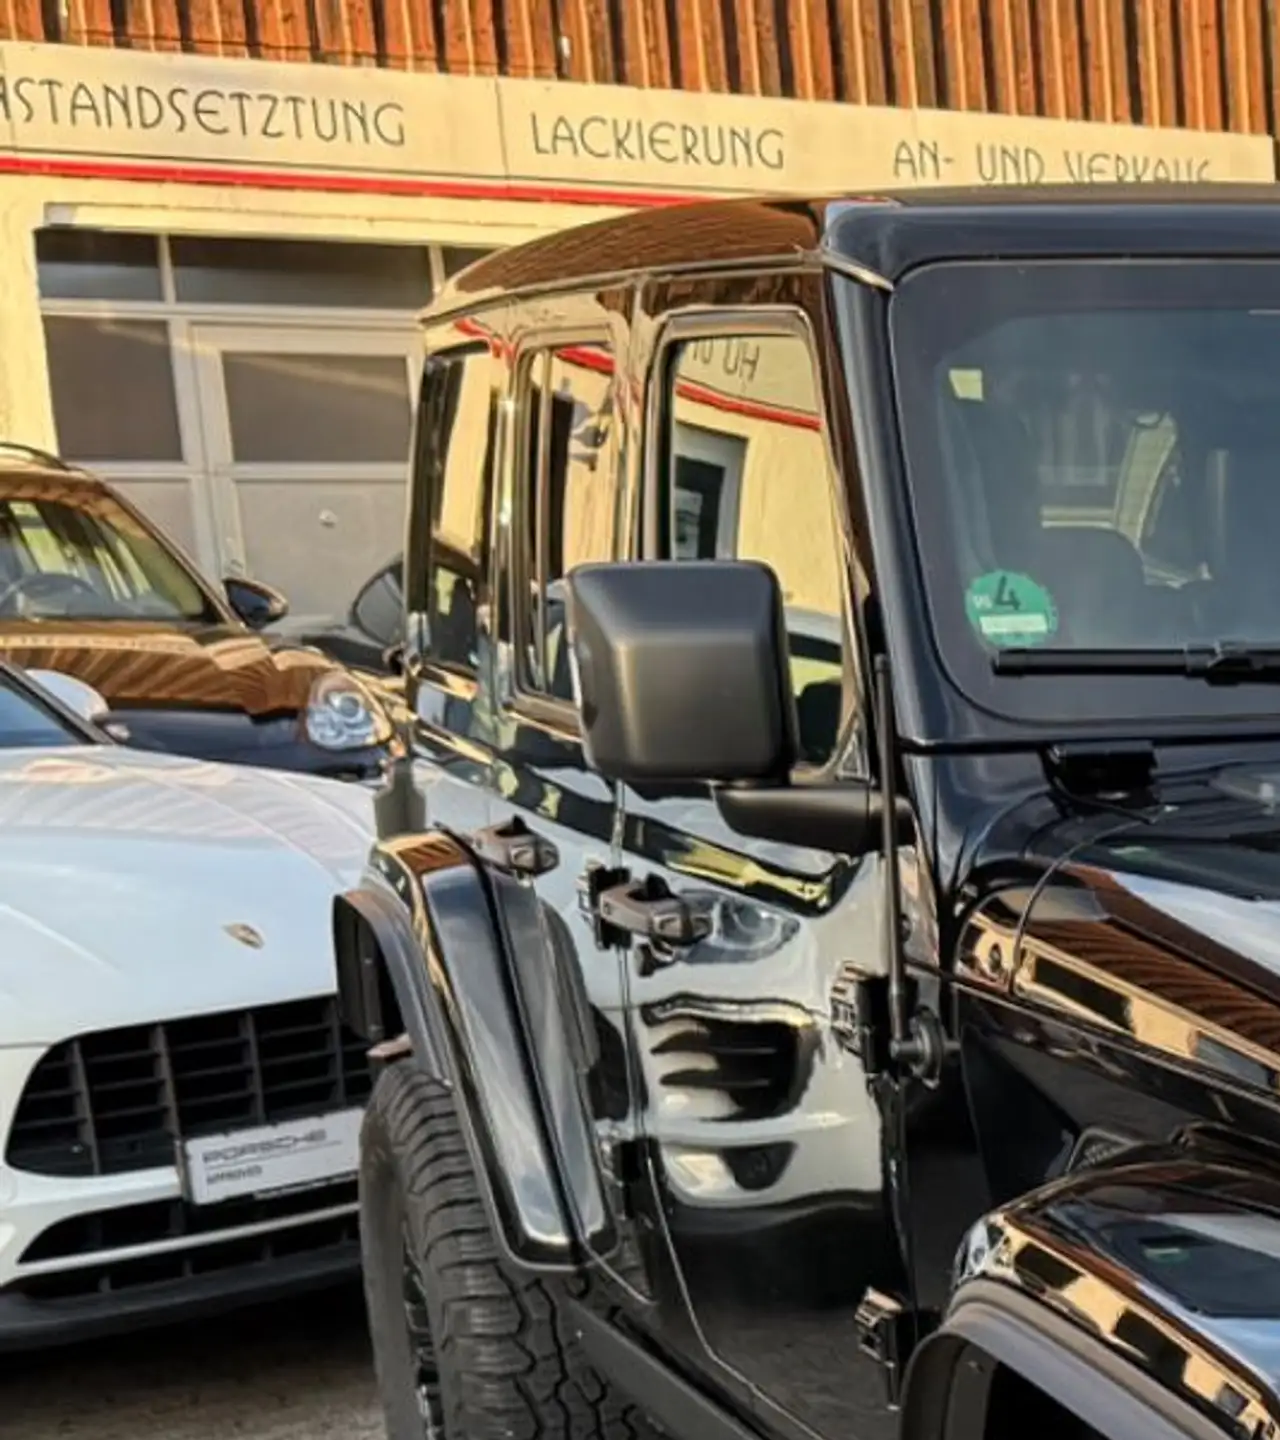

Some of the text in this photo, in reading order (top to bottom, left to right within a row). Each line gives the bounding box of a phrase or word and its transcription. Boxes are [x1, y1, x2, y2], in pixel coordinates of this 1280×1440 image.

[531, 112, 786, 170] LACKIERUNG
[893, 139, 955, 182] AN-
[975, 142, 1046, 186] UND
[995, 575, 1022, 611] 4
